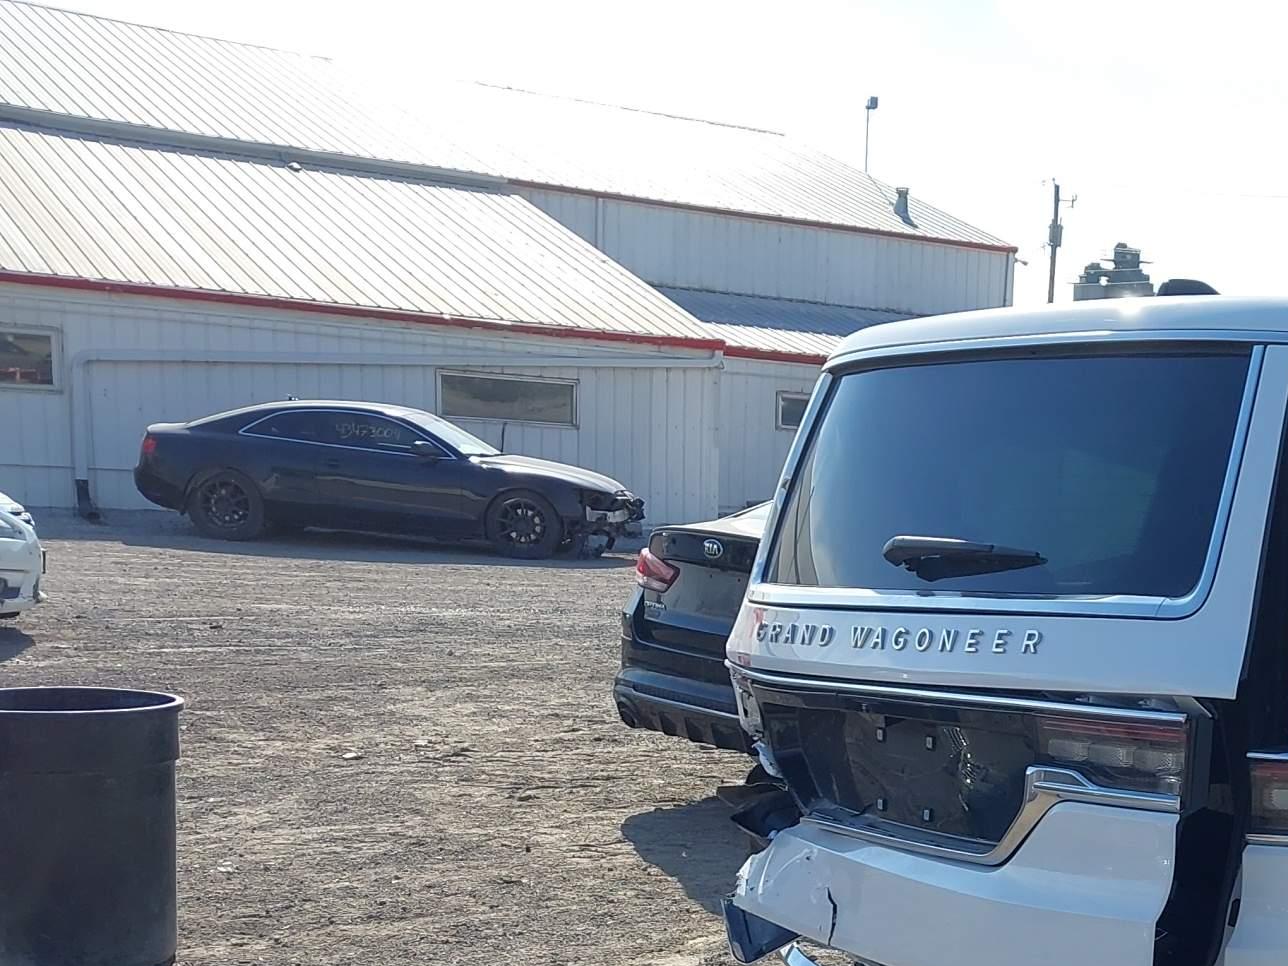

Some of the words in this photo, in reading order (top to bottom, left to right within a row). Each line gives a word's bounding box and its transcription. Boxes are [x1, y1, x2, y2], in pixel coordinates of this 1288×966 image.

[704, 541, 720, 556] KIA
[755, 621, 834, 647] GRAND
[850, 624, 1043, 653] WAGONEER
